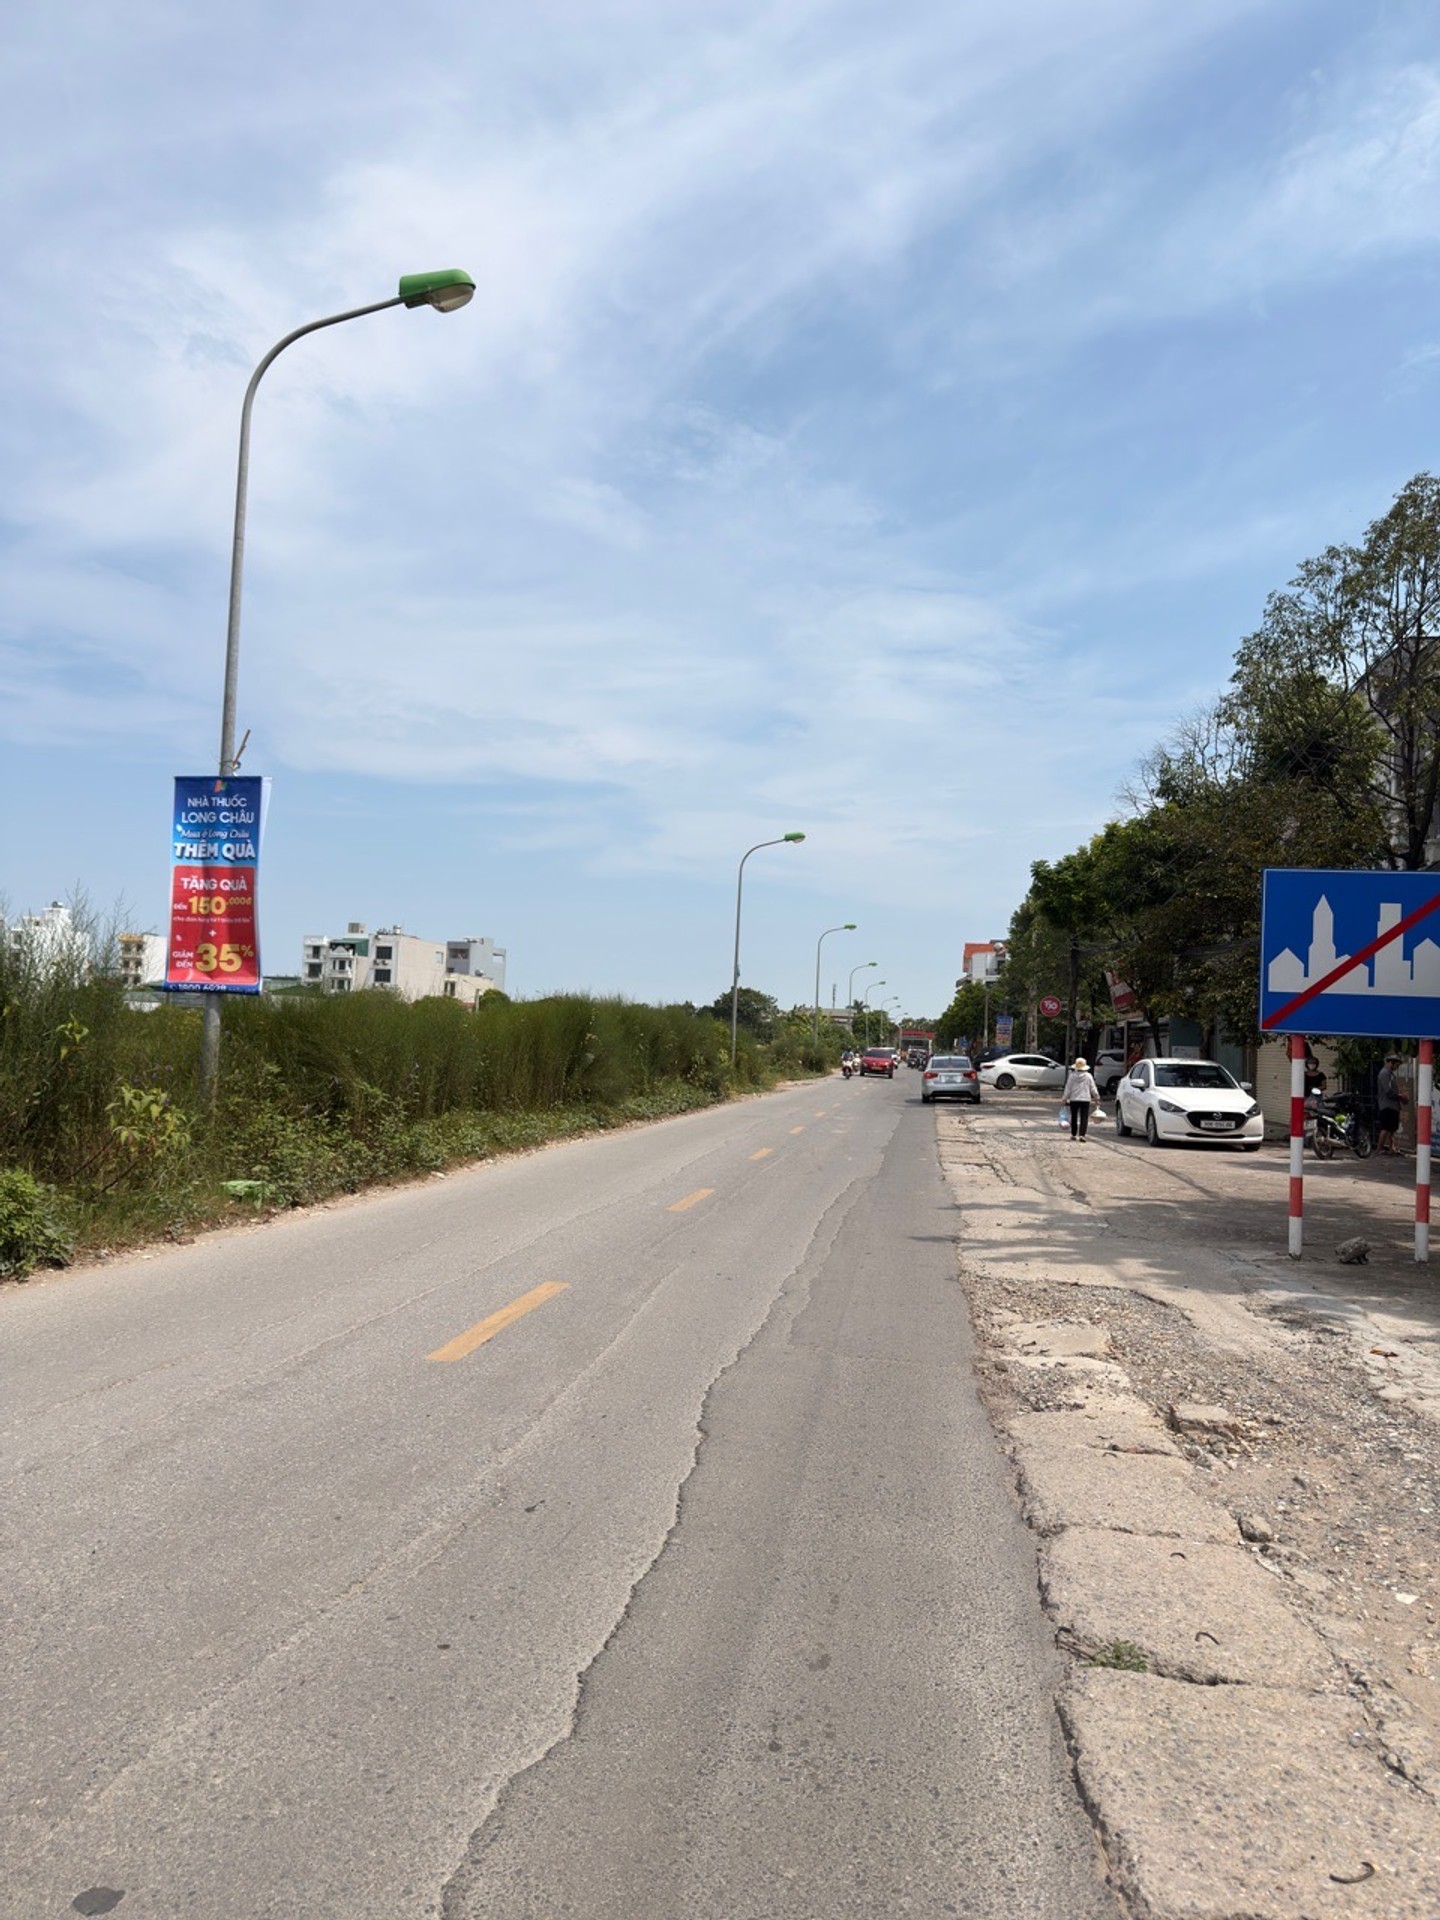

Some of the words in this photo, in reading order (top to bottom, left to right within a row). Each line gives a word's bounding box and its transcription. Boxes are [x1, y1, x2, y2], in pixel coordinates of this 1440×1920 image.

[187, 795, 209, 807] NHÀ
[211, 794, 247, 807] THUỐC
[182, 811, 217, 823] LONG
[219, 809, 255, 823] CHÂU
[174, 839, 219, 858] THÊM
[222, 839, 256, 861] QUÀ
[180, 875, 218, 894] TẶNG
[219, 876, 247, 891] QUÀ
[172, 949, 194, 958] GIẢM
[176, 958, 193, 968] ĐẾN
